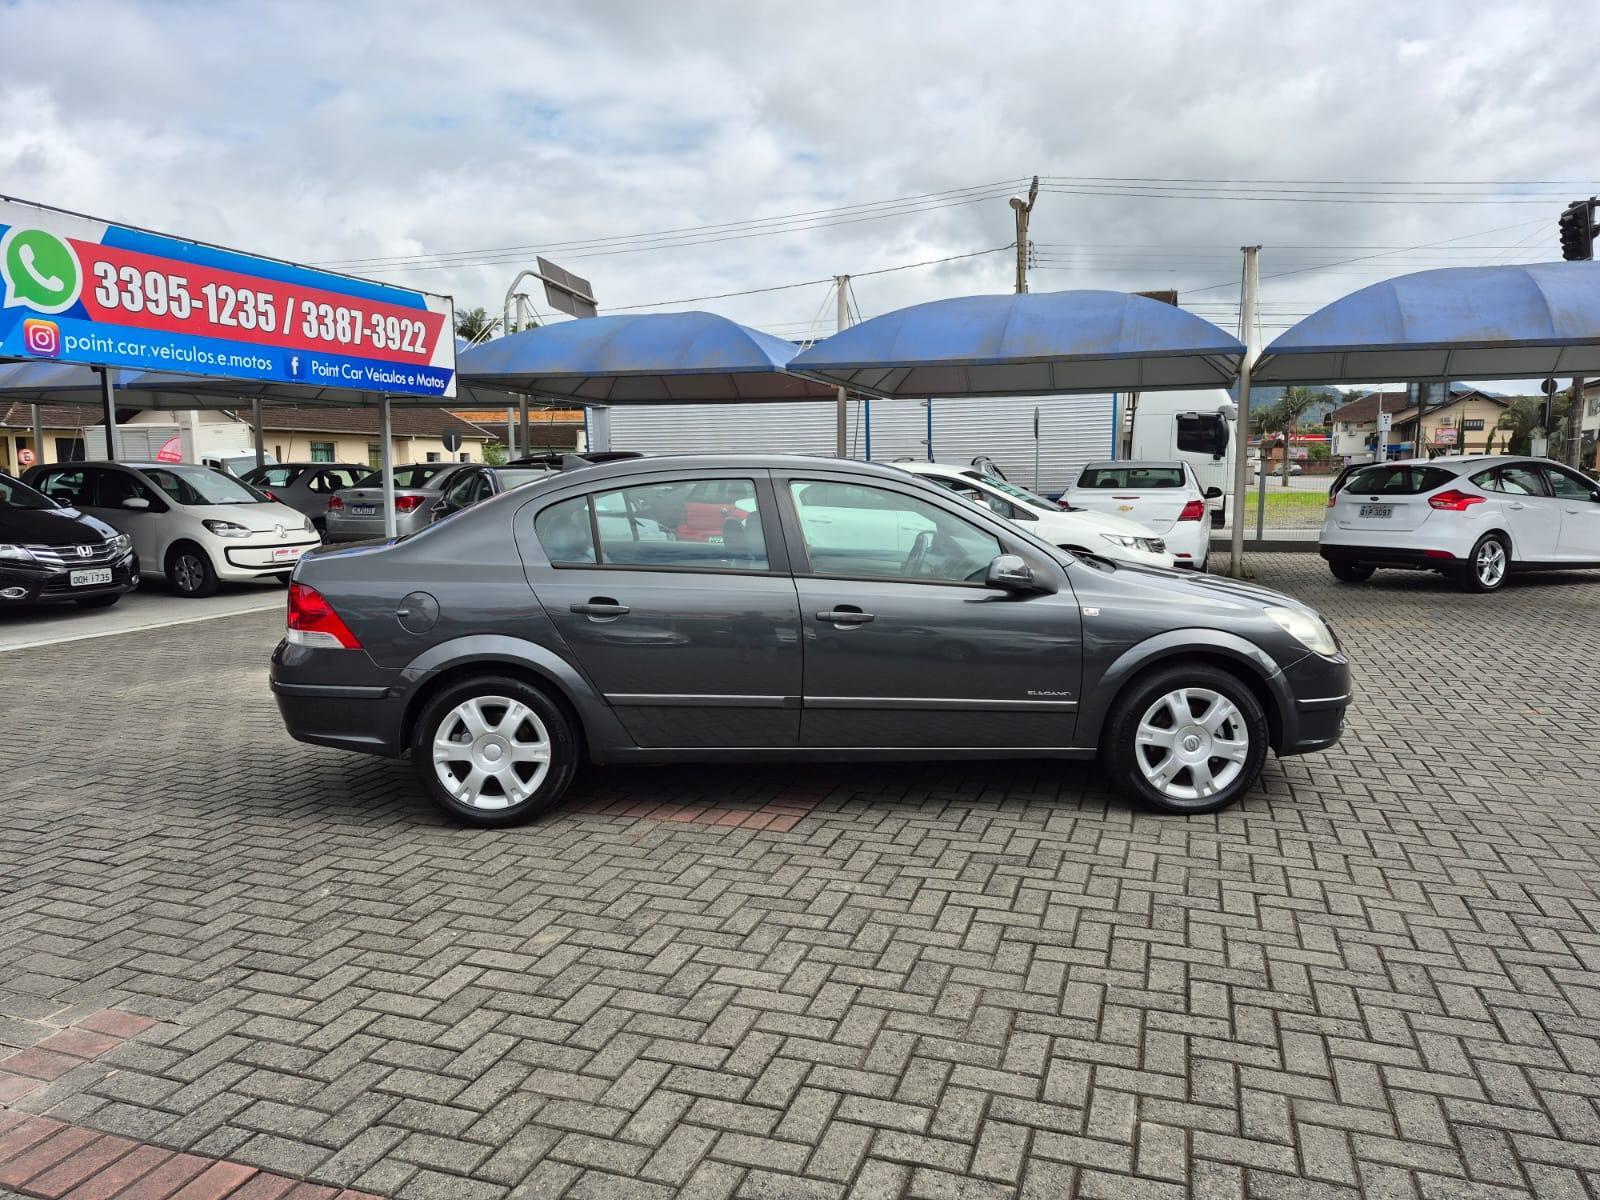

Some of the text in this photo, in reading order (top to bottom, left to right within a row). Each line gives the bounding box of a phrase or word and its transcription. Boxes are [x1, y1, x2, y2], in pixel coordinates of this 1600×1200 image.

[93, 261, 427, 354] 3395-1235 / 3387-3922
[64, 334, 273, 371] point.car.veiculos.e.motos
[311, 360, 339, 378] Point
[341, 364, 363, 380] Car
[407, 375, 414, 386] e
[416, 373, 445, 389] Motos
[91, 573, 110, 583] 1735
